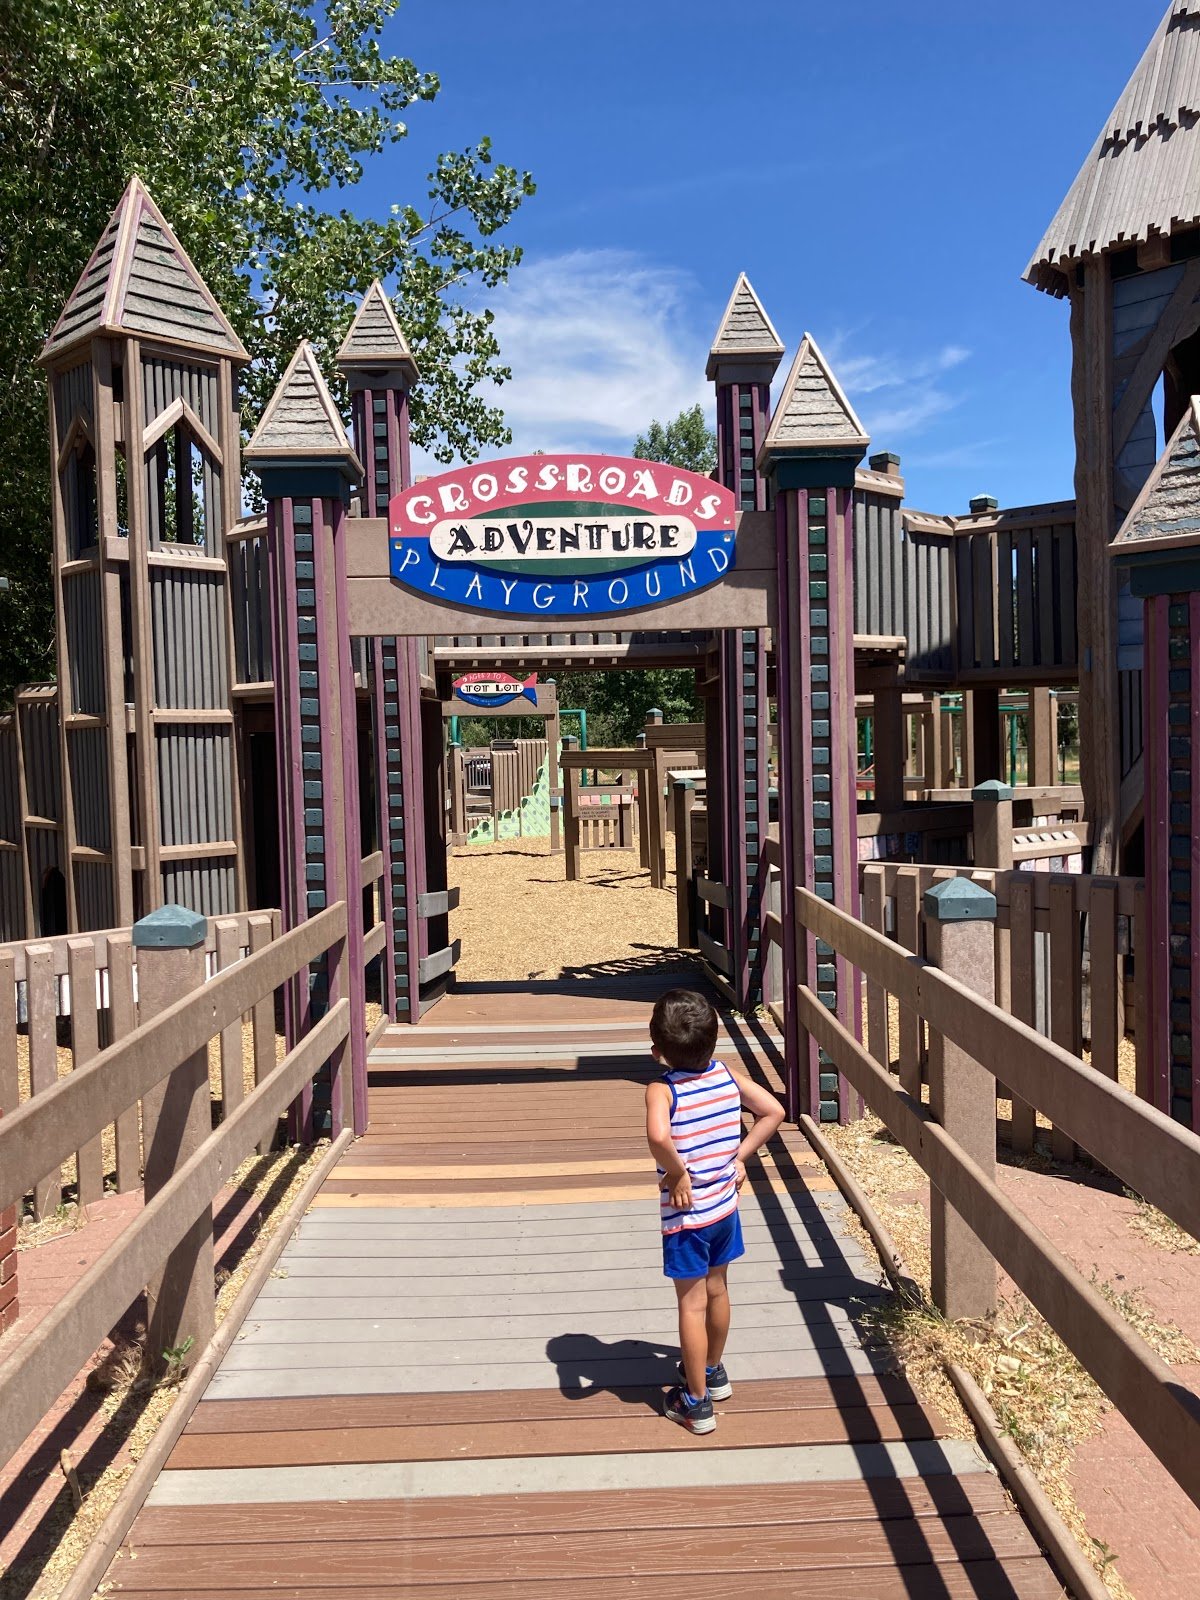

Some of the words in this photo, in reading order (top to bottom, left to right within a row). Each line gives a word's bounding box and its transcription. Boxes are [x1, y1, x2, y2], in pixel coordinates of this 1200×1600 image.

[447, 520, 680, 555] ADVENTURE
[399, 548, 729, 609] PLAYGROUND
[469, 673, 485, 682] AGES
[493, 672, 502, 680] TO
[465, 684, 489, 693] TOT
[495, 684, 520, 692] LOT
